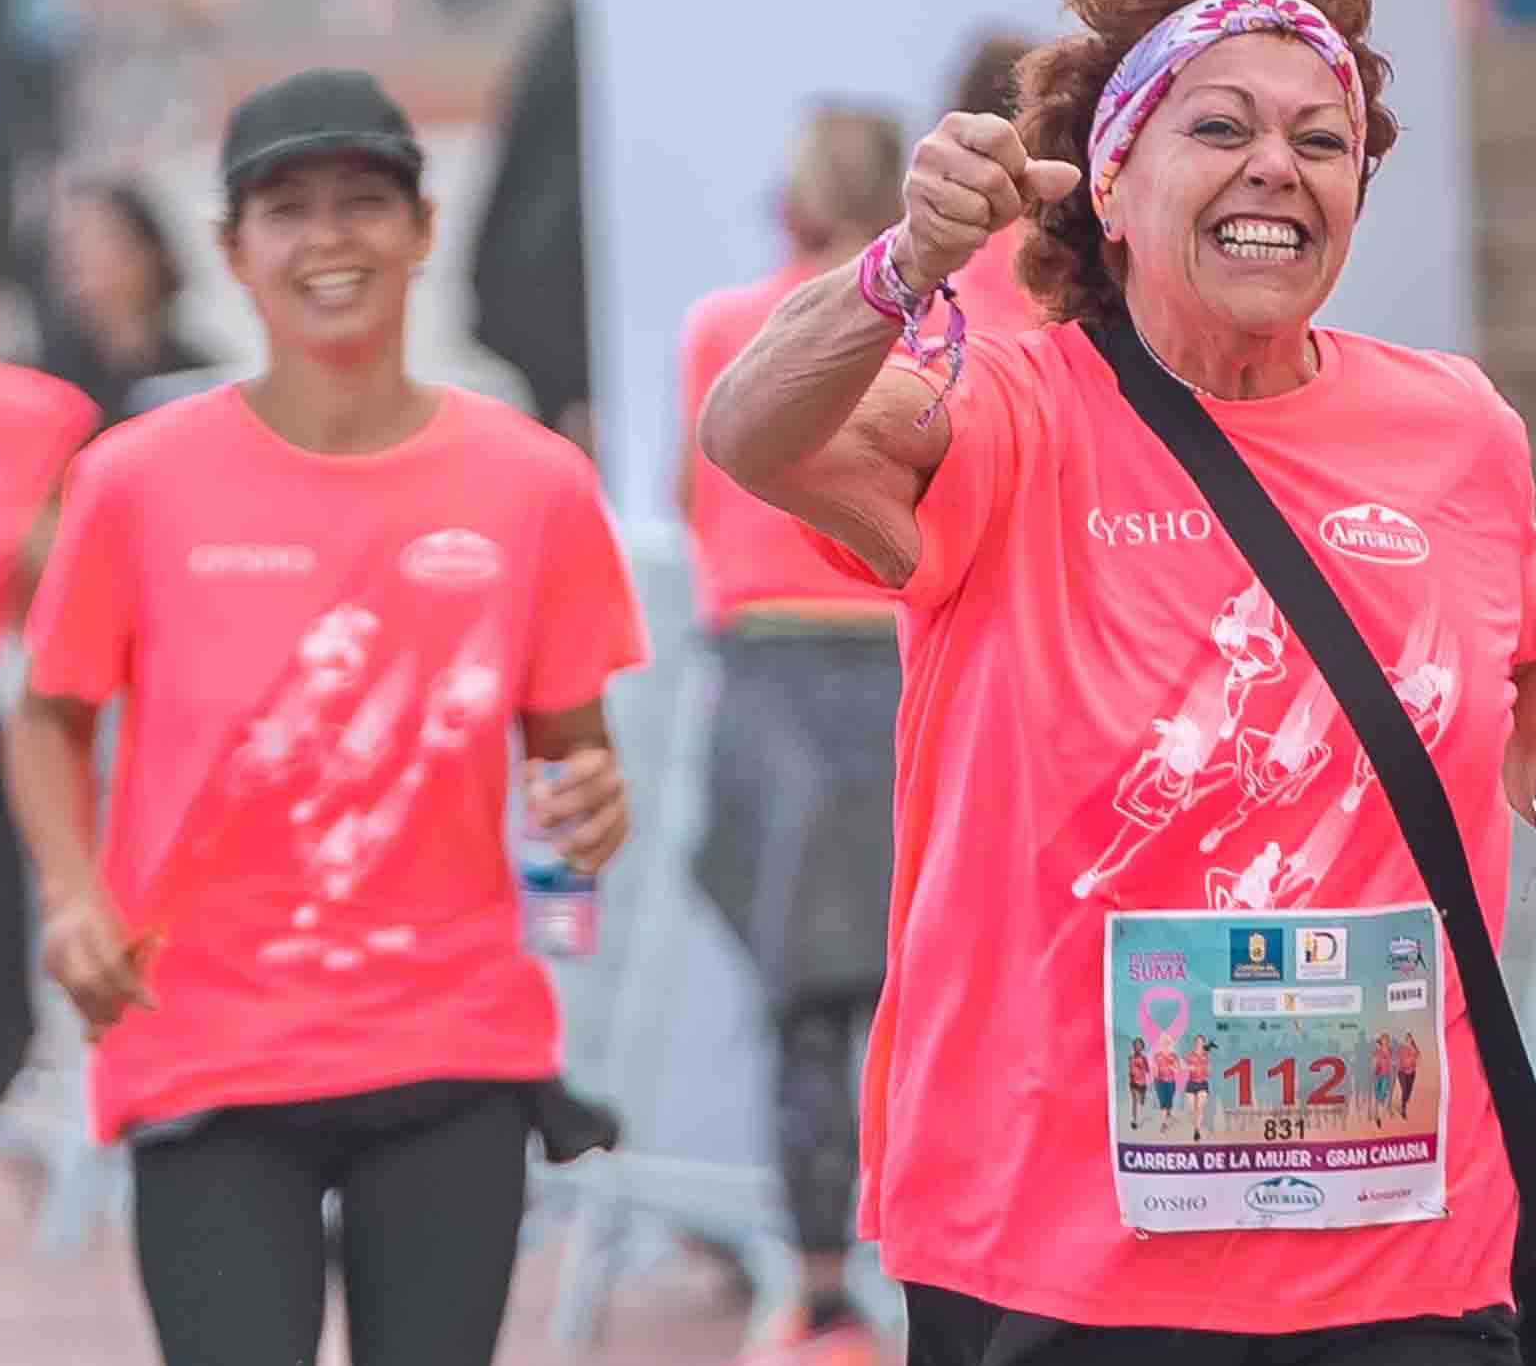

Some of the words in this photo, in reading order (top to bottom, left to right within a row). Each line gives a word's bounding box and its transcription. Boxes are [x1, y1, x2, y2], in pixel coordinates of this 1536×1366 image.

[1088, 507, 1211, 546] OYSHO
[1224, 1057, 1345, 1107] 112
[1264, 1119, 1305, 1141] 831
[1123, 1150, 1200, 1170] CARRERA
[1203, 1150, 1226, 1169] DE
[1229, 1151, 1250, 1169] LA
[1254, 1149, 1311, 1168] MUJER
[1326, 1147, 1367, 1167] GRAN
[1370, 1140, 1429, 1163] CANARIA
[1144, 1195, 1207, 1212] OYSHO
